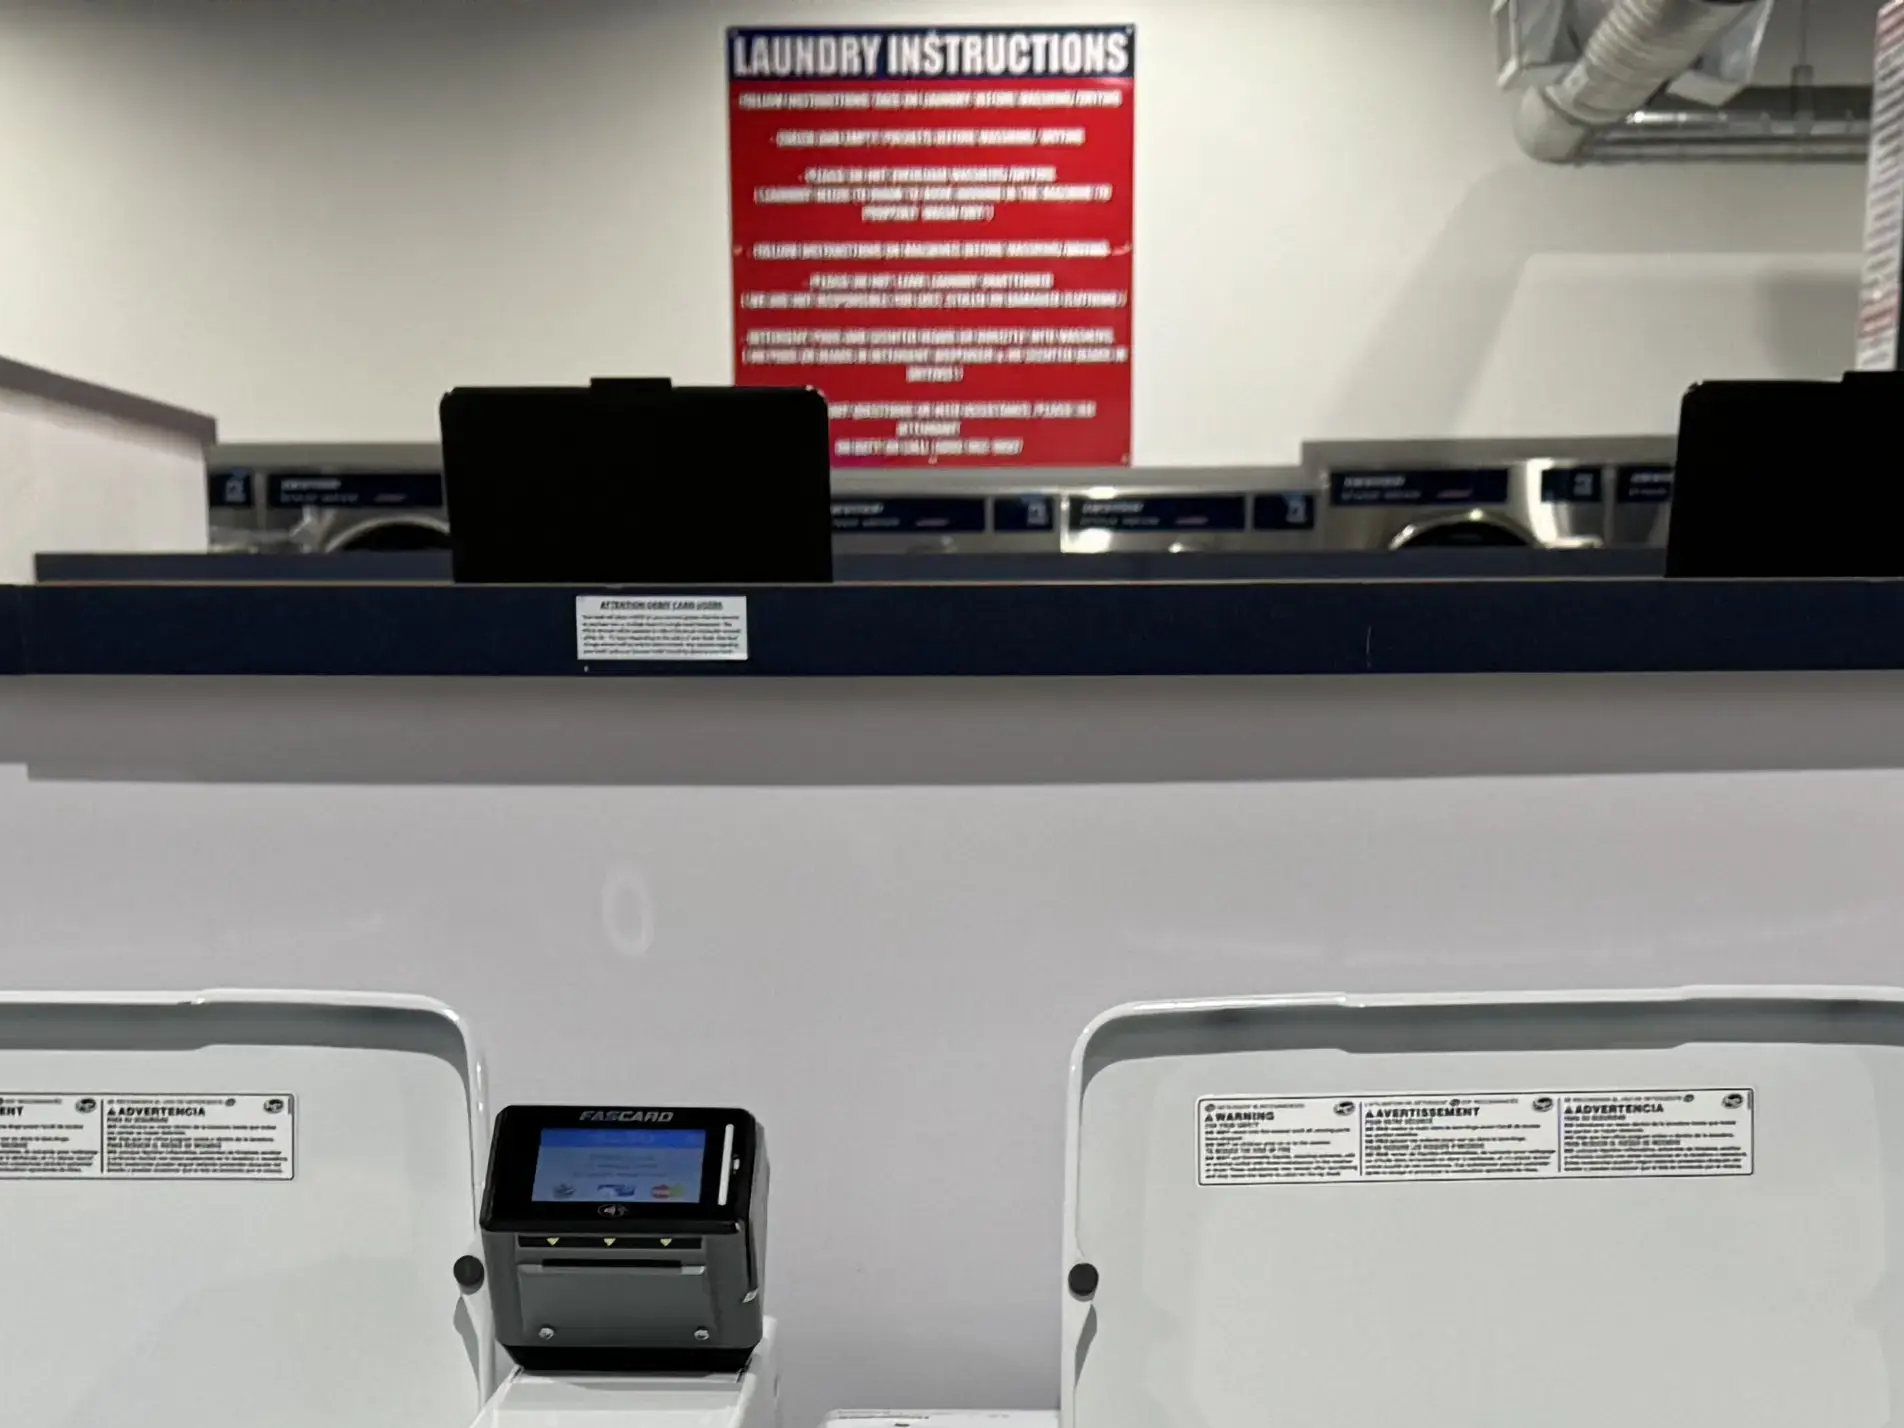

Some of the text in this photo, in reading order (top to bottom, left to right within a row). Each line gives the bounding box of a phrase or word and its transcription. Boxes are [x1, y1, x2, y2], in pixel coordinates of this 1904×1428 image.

[734, 32, 1128, 75] LAUNDRY INSTRUCTIONS
[119, 1107, 205, 1117] ADVERTENCIA
[1377, 1107, 1480, 1117] AVERTISSEMENT
[1575, 1104, 1664, 1114] ADVERTENCIA
[579, 1110, 674, 1123] FASCARD
[1216, 1111, 1275, 1121] WARNING
